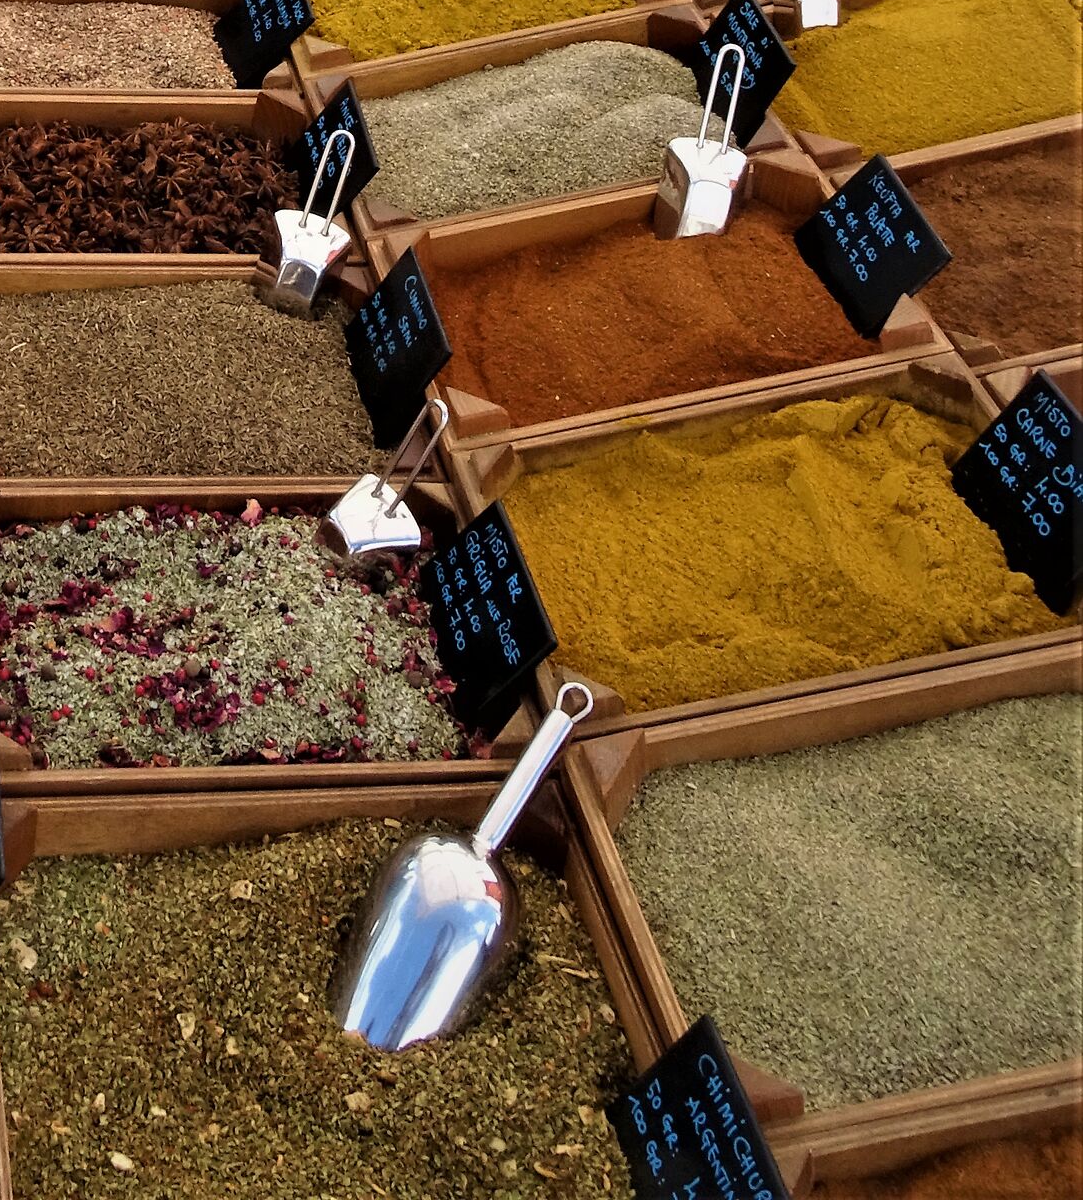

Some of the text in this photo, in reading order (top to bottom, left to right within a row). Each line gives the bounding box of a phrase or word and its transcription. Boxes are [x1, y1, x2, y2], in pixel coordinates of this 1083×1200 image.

[728, 12, 763, 69] MONTAGNA
[740, 1, 759, 30] SALE
[699, 40, 711, 56] 100
[304, 132, 314, 147] 100
[835, 194, 846, 209] 50
[858, 235, 877, 262] 4.00
[865, 202, 895, 247] POLPETTE
[868, 170, 920, 253] KEUFTA PER
[819, 210, 836, 227] 100
[849, 249, 868, 281] 7.00
[360, 308, 368, 324] 100
[372, 291, 381, 308] 50
[404, 275, 427, 329] CUMINO
[1016, 408, 1057, 459] CARNE
[1035, 392, 1071, 437] MISTO
[979, 443, 1051, 536] 100 GR: 7.00
[994, 423, 1064, 514] 50 GR: 4.00
[448, 546, 457, 565] 50
[463, 598, 481, 633] 4.00
[484, 523, 522, 604] MISTO PER
[433, 560, 445, 583] 100
[449, 608, 466, 651] 7.00
[497, 619, 520, 664] ROSE
[628, 1095, 665, 1185] 100 GR:
[646, 1078, 662, 1110] 50
[662, 1114, 679, 1157] GR:
